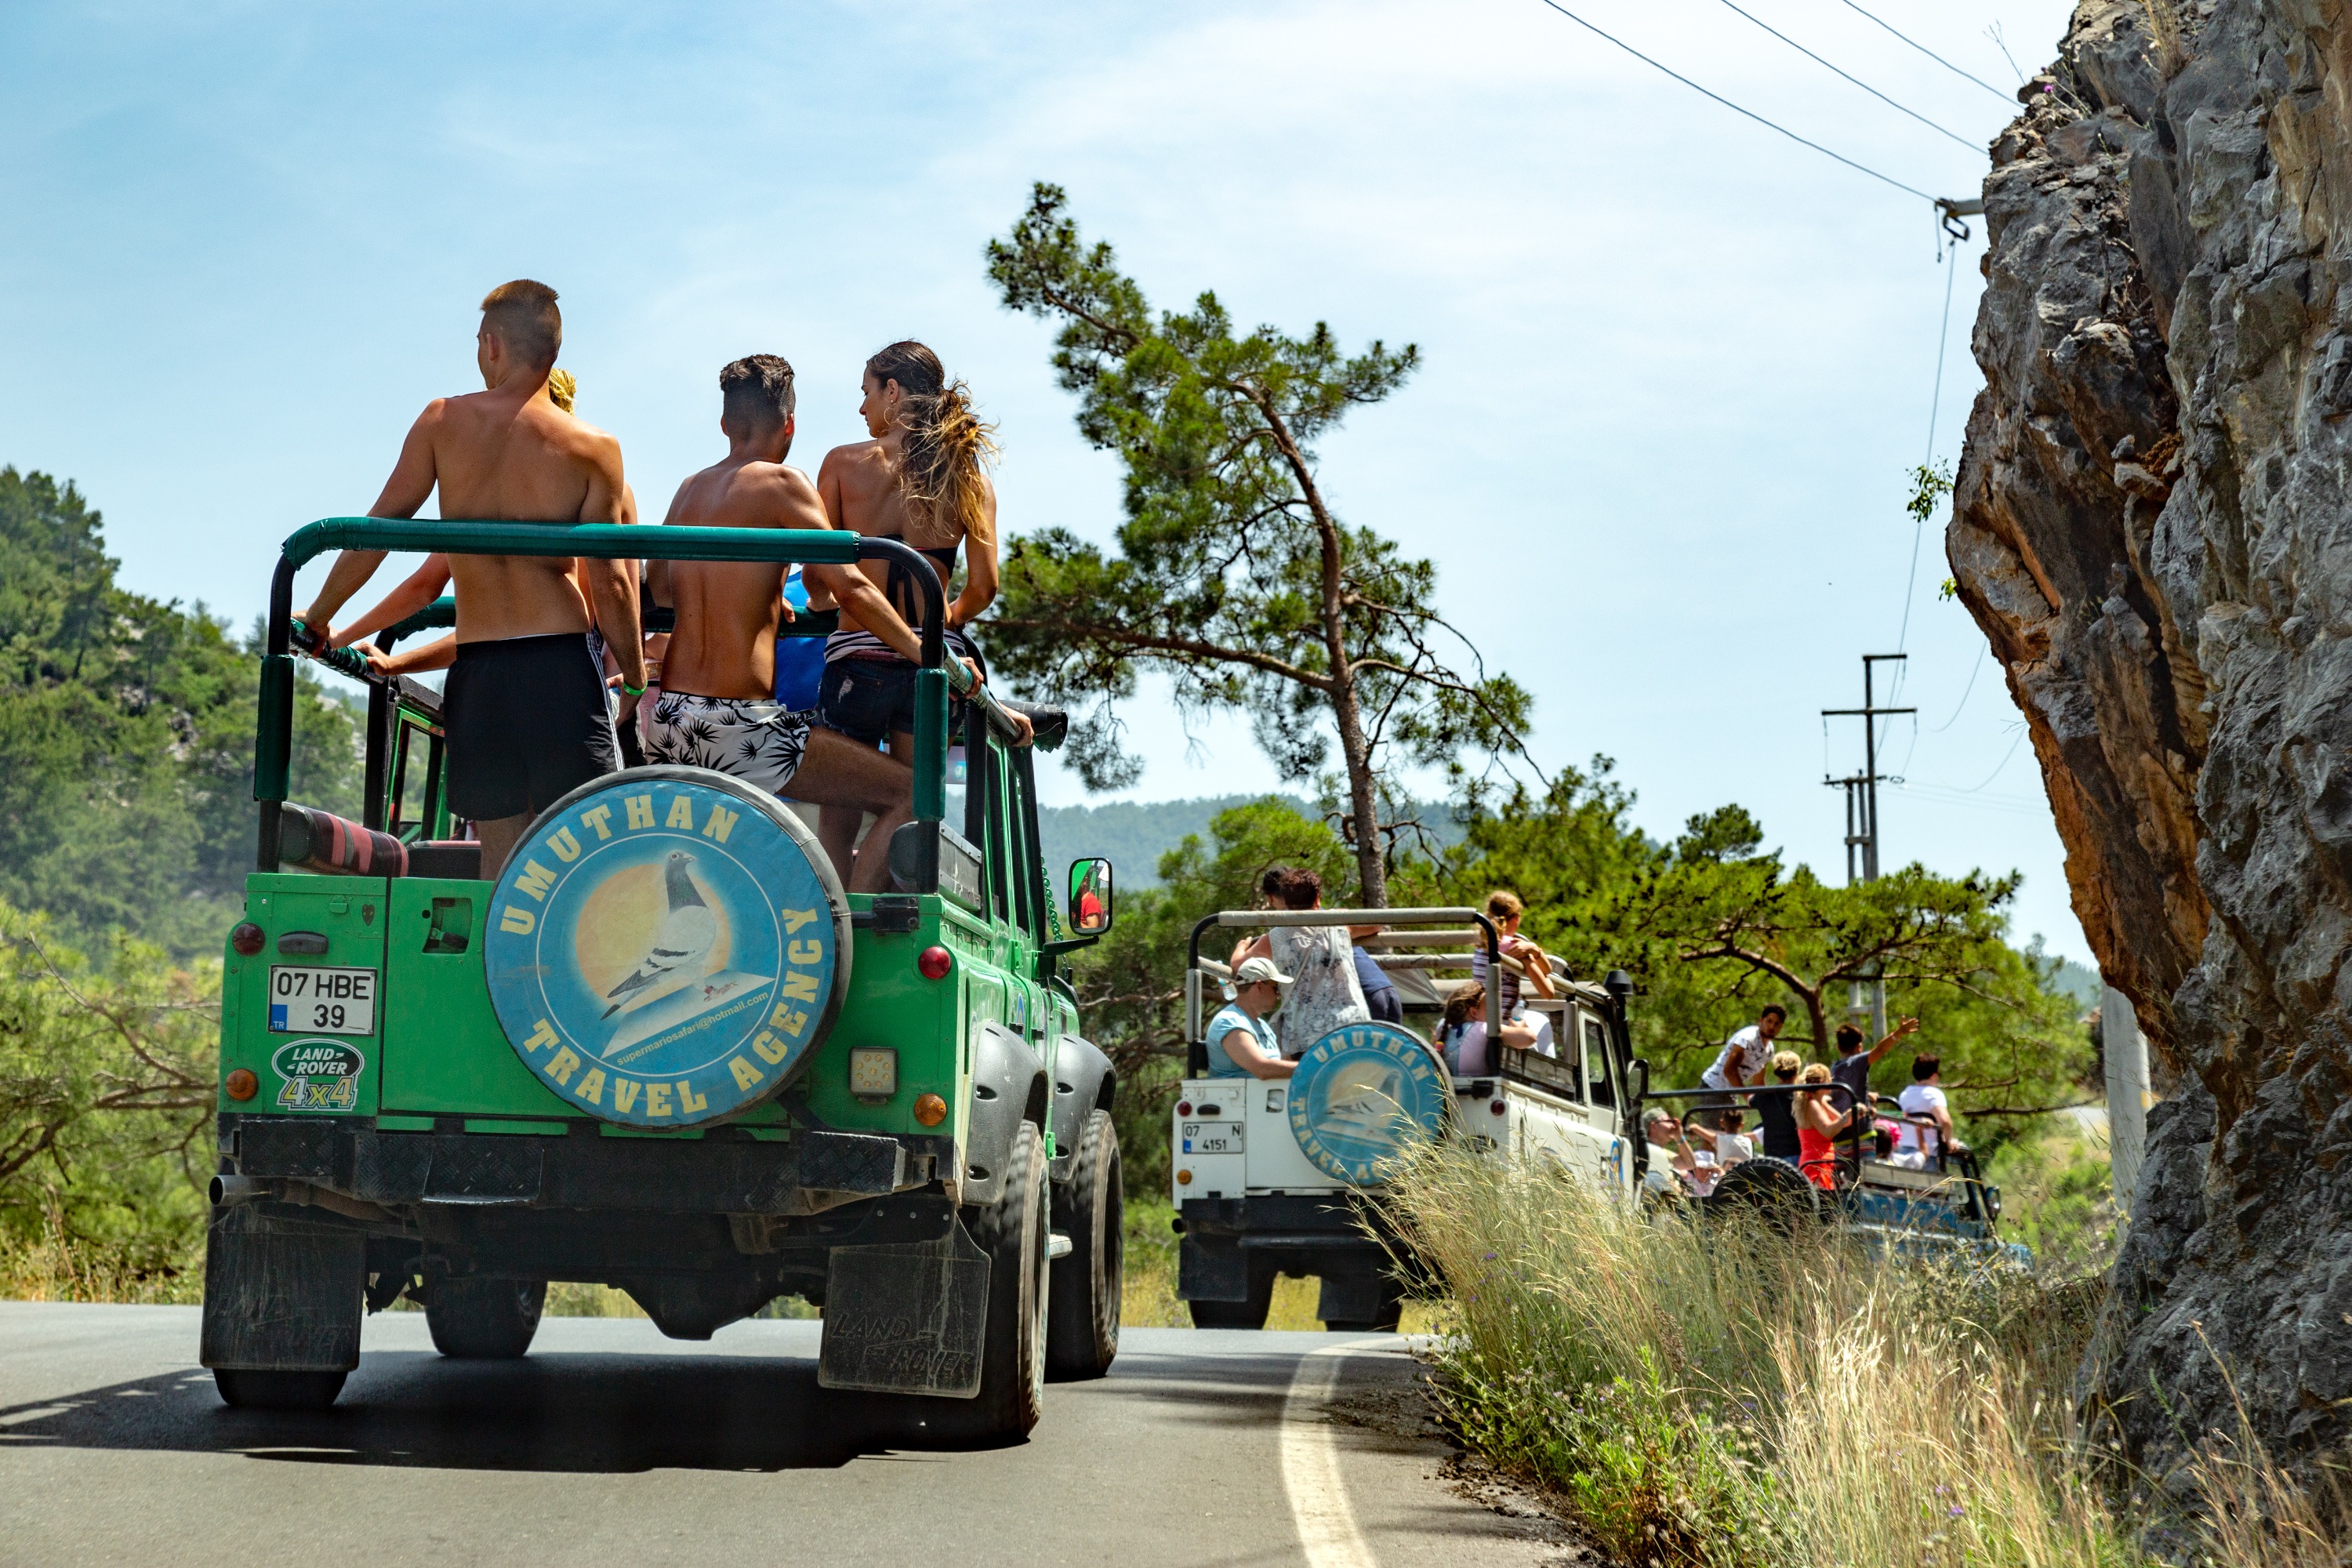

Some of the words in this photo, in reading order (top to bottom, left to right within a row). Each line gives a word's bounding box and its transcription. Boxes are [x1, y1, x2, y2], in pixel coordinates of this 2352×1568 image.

[500, 794, 739, 935] UMUTHAN
[277, 971, 309, 996] 07
[314, 973, 371, 1000] HBE
[274, 1021, 285, 1029] TR
[314, 1004, 345, 1029] 39
[523, 1018, 709, 1117] TRAVEL
[728, 906, 822, 1092] AGENCY
[616, 992, 769, 1065] supermariosafari@hotmail.com
[292, 1047, 336, 1061] LAND
[1312, 1029, 1431, 1080] UMUTHAN
[295, 1062, 348, 1075] ROVER
[1185, 1125, 1200, 1137] 07
[1232, 1124, 1241, 1136] N
[1290, 1097, 1345, 1175] TRAVEL
[1203, 1139, 1227, 1150] 4151
[831, 1312, 912, 1339] LAND
